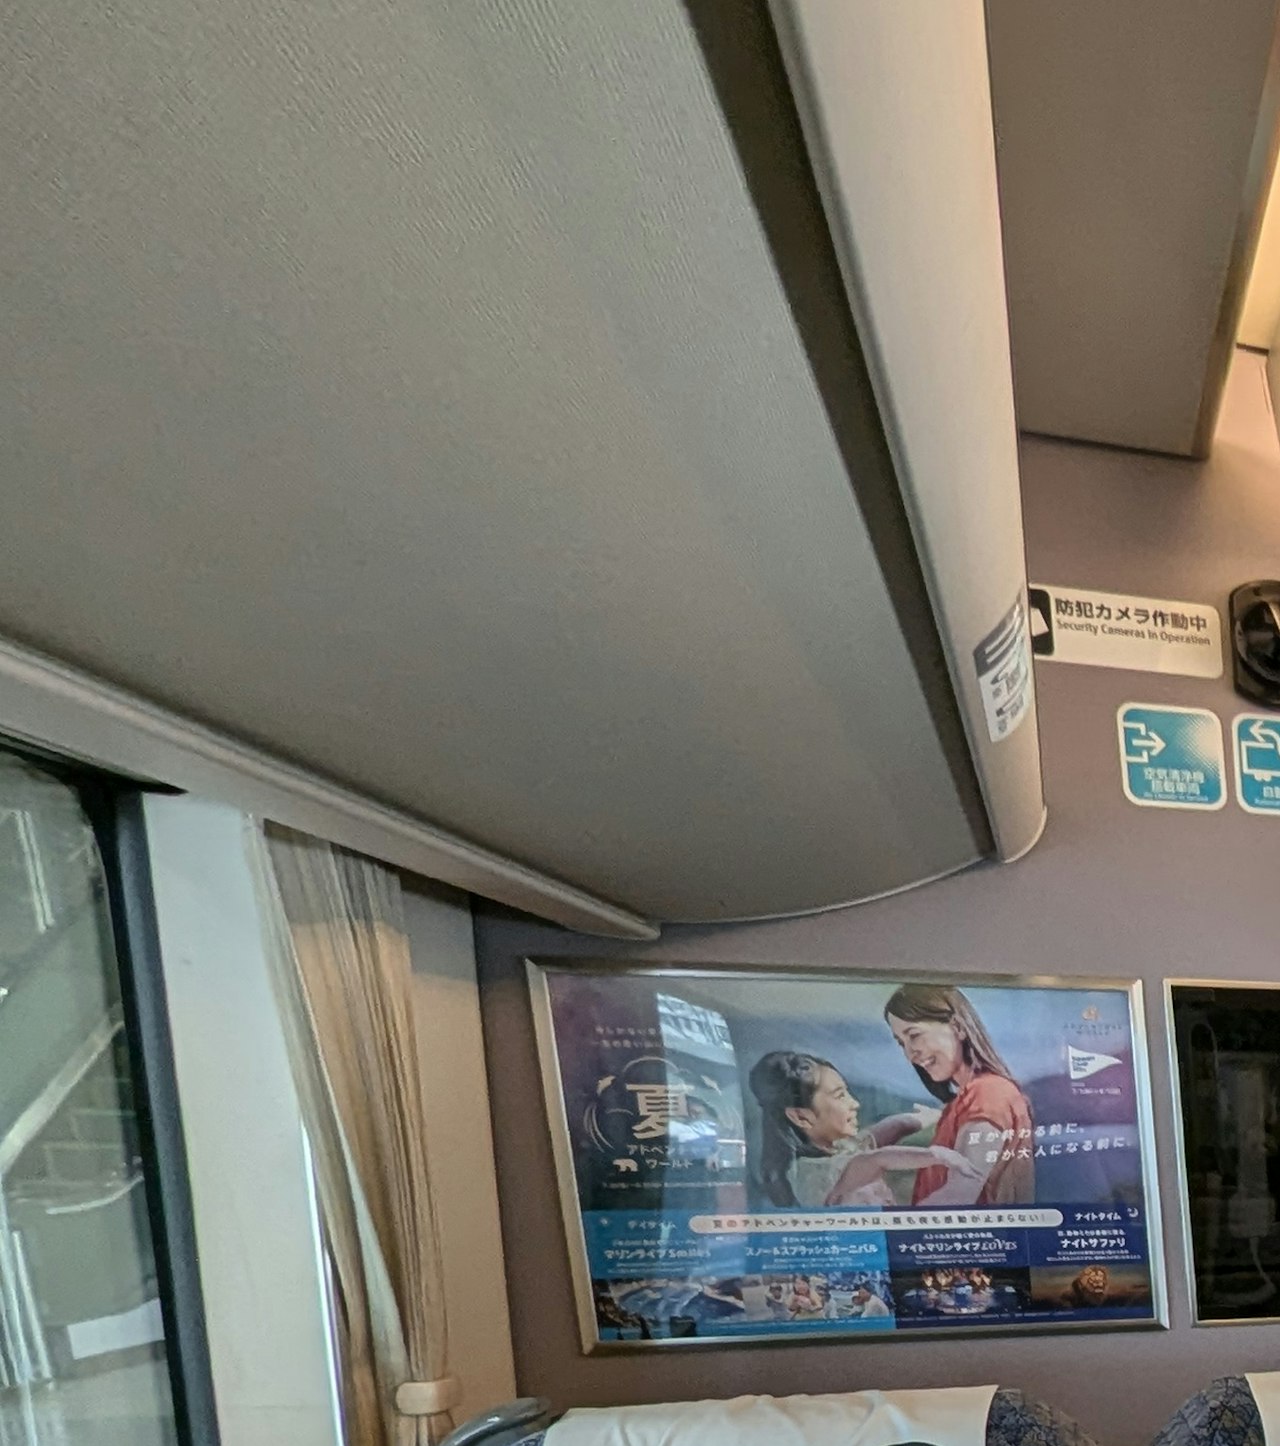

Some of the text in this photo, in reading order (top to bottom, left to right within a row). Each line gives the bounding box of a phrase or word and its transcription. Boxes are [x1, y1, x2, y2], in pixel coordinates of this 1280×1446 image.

[1055, 597, 1208, 632] 防犯カメラ作動中
[1057, 619, 1099, 637] Security
[1101, 624, 1145, 640] Cameras
[1160, 632, 1211, 647] Operation
[1074, 1212, 1122, 1221] ナイトタイム
[1060, 1237, 1126, 1249] ナイトサファリ
